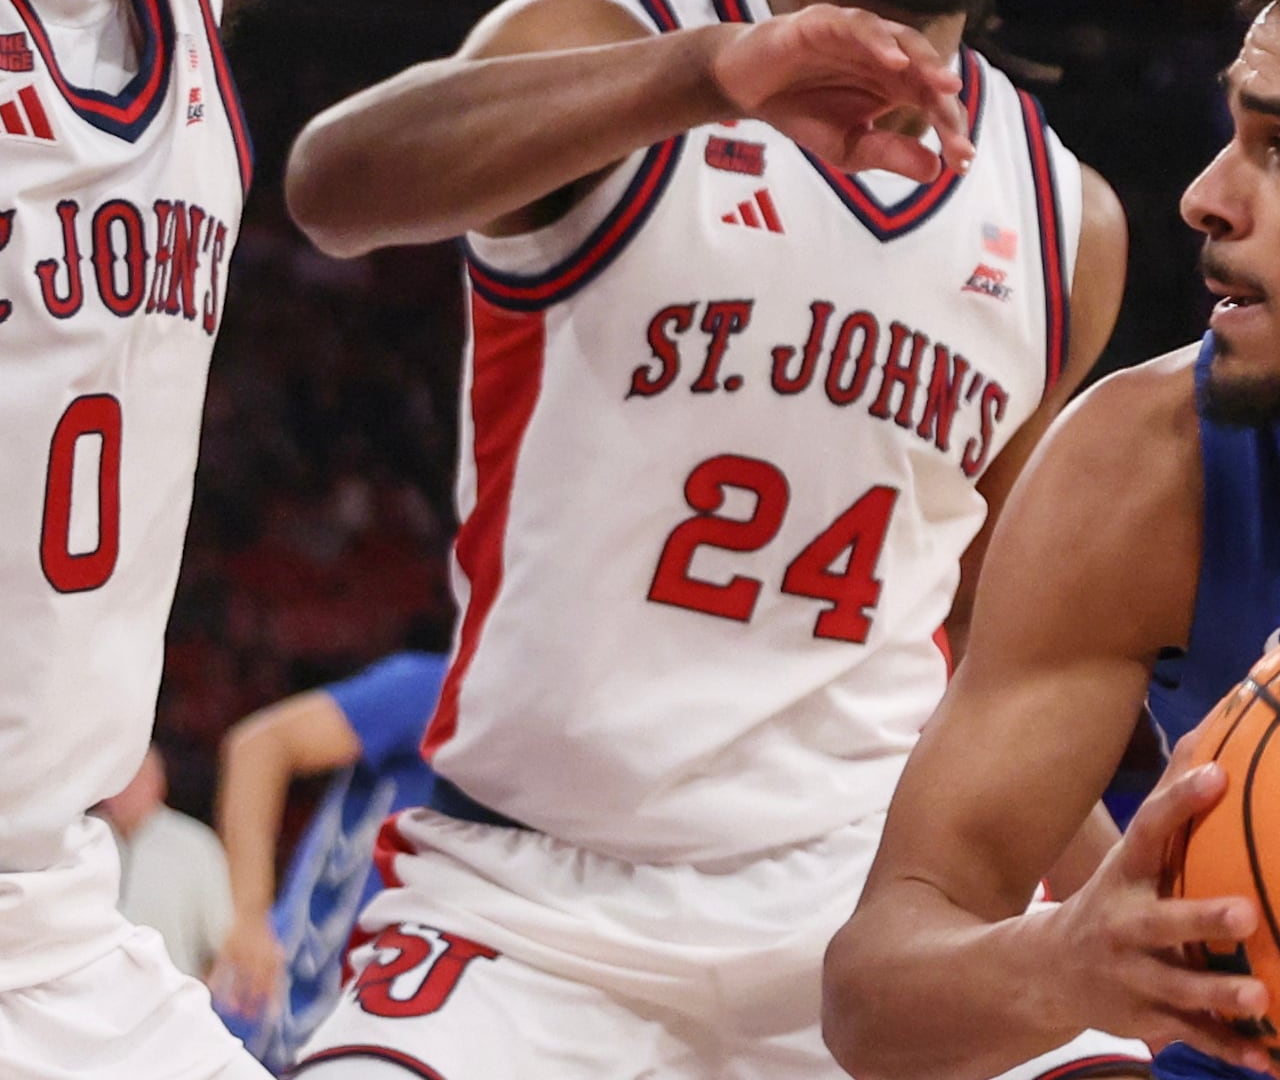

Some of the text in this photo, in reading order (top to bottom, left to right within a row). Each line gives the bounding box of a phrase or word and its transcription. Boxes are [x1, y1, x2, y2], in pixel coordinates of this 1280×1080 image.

[35, 199, 228, 337] JOHN'S
[624, 298, 1010, 478] ST. JOHN'S
[39, 393, 123, 595] 0
[646, 453, 901, 645] 24
